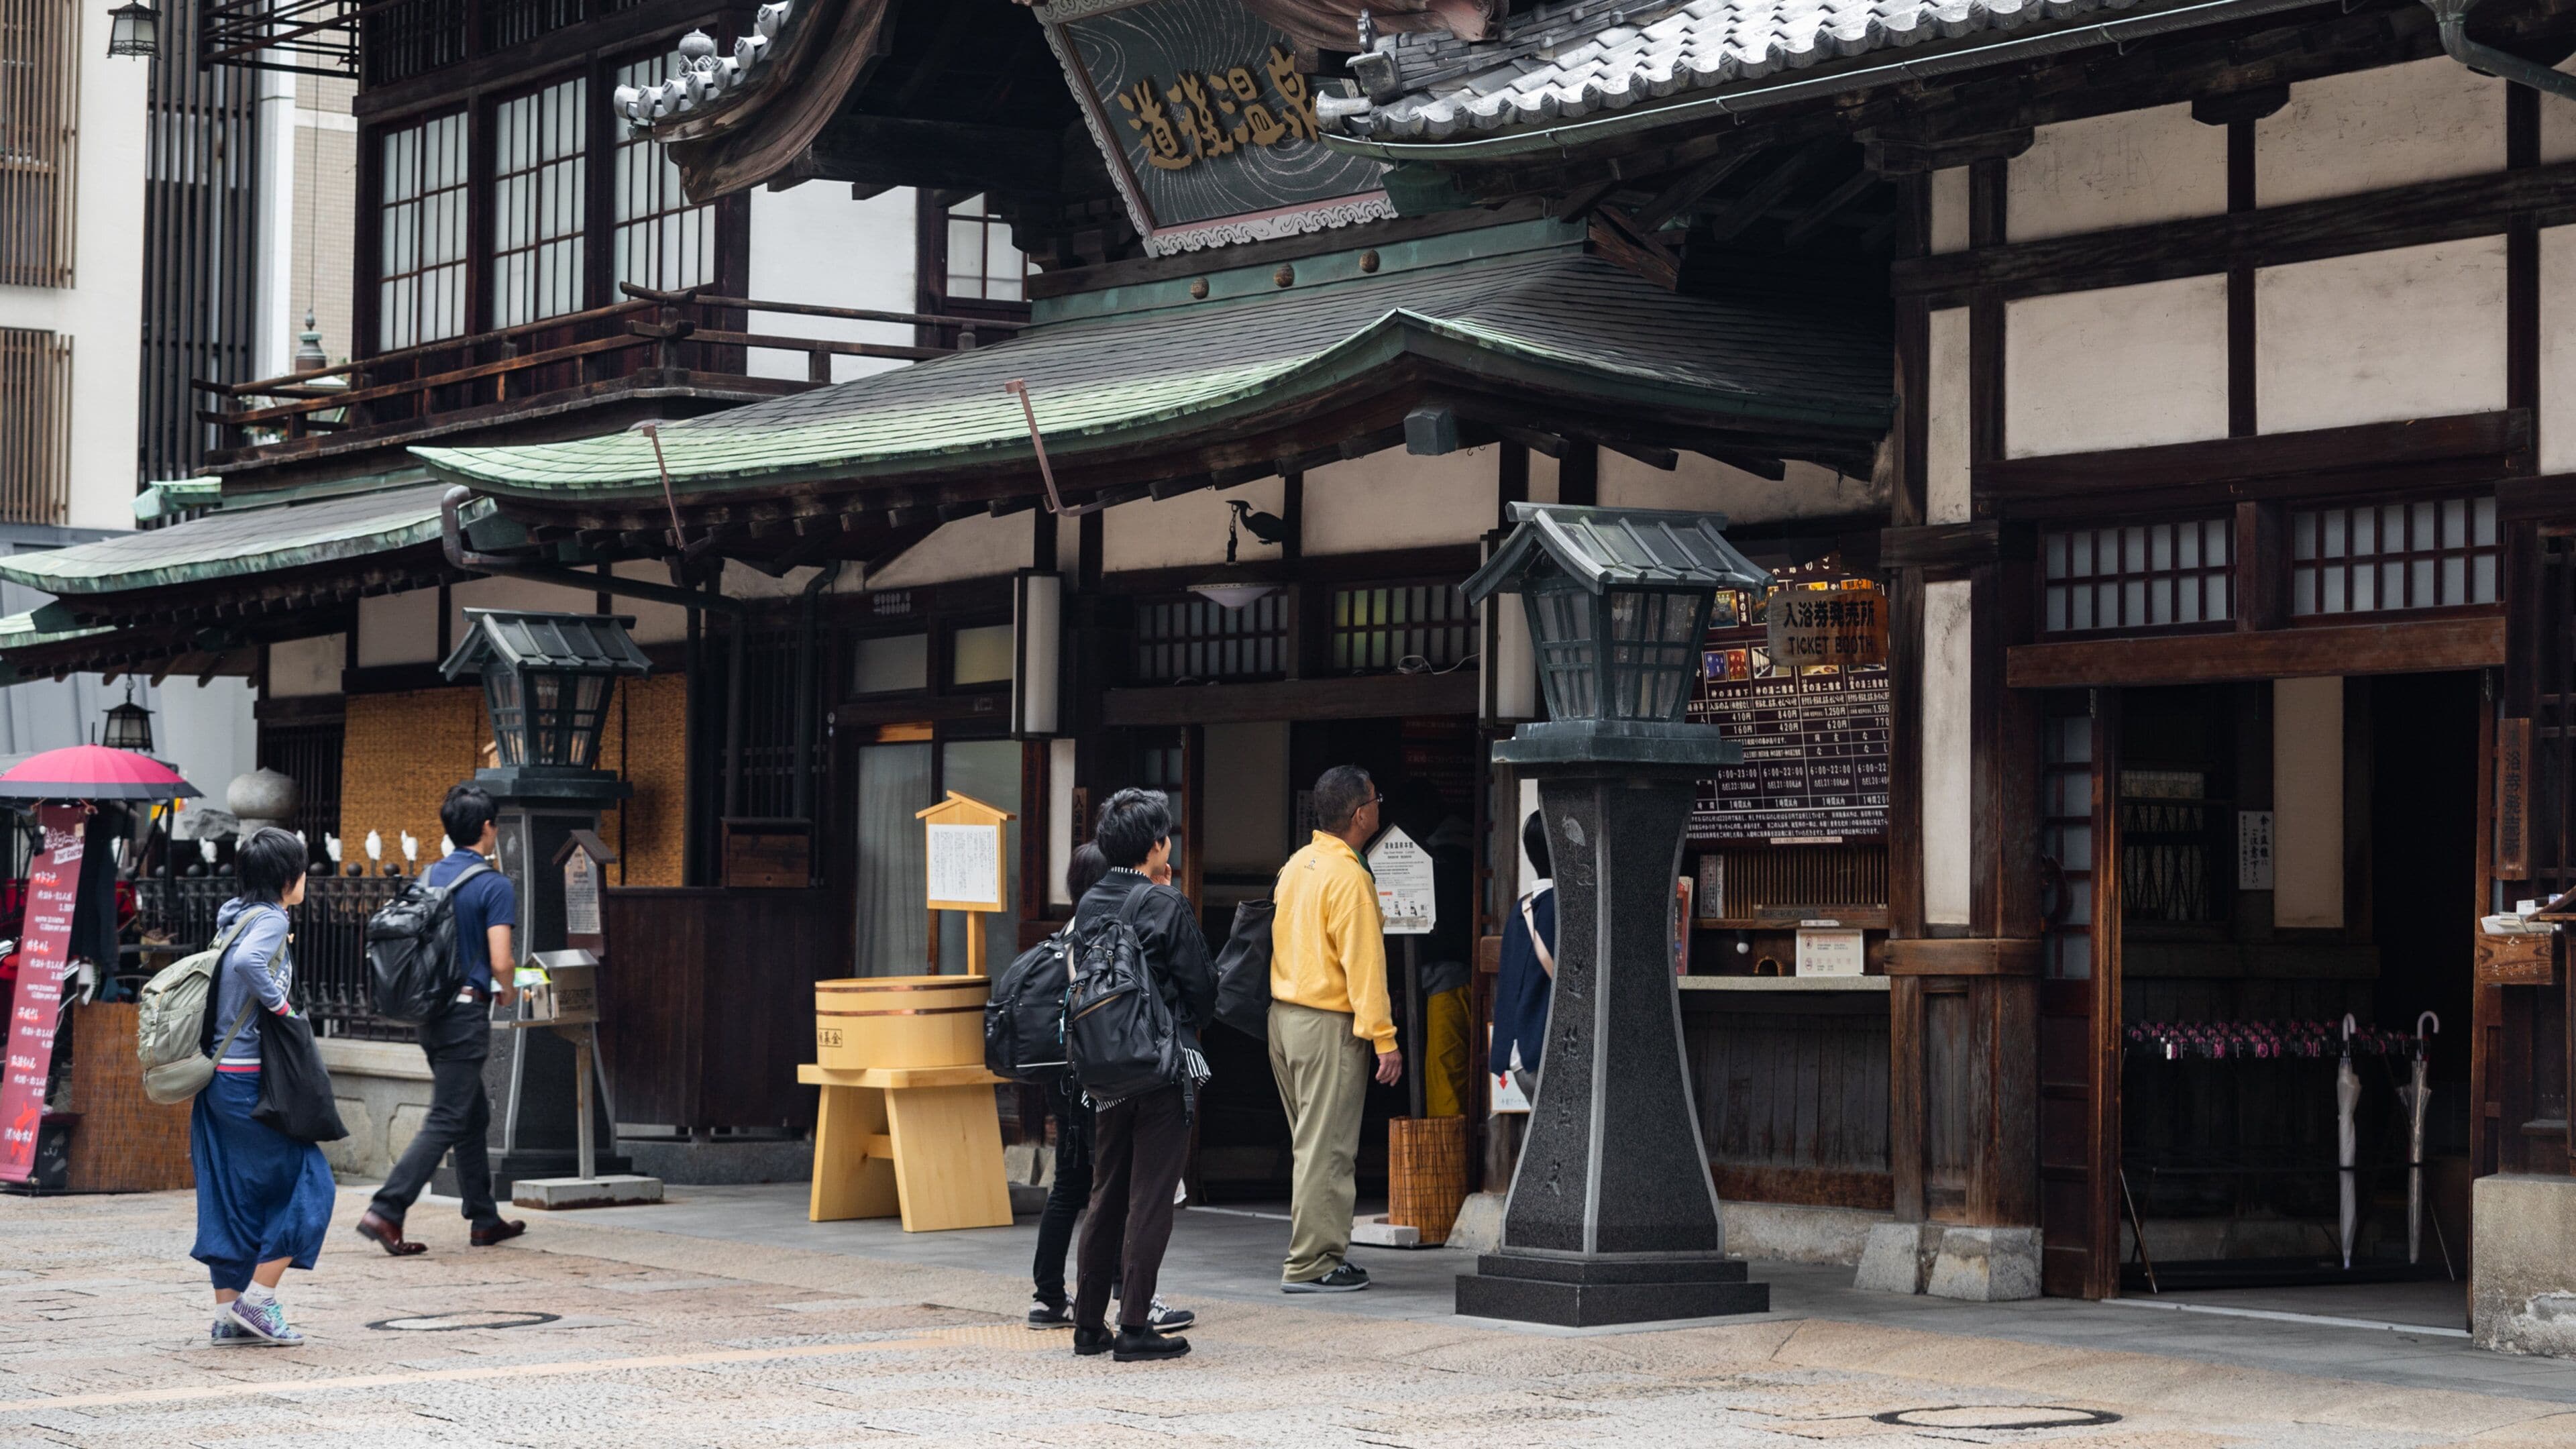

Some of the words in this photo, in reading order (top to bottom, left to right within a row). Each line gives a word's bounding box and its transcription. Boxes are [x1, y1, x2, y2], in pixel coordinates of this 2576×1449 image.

[1784, 600, 1875, 628] 入浴券発売所
[1788, 637, 1829, 655] TICKET
[1835, 635, 1873, 654] BOOTH
[1732, 712, 1751, 721] 410円
[1778, 710, 1797, 720] 840円
[1734, 725, 1752, 735] 160円
[1779, 722, 1799, 732] 420円
[1827, 720, 1847, 730] 620円
